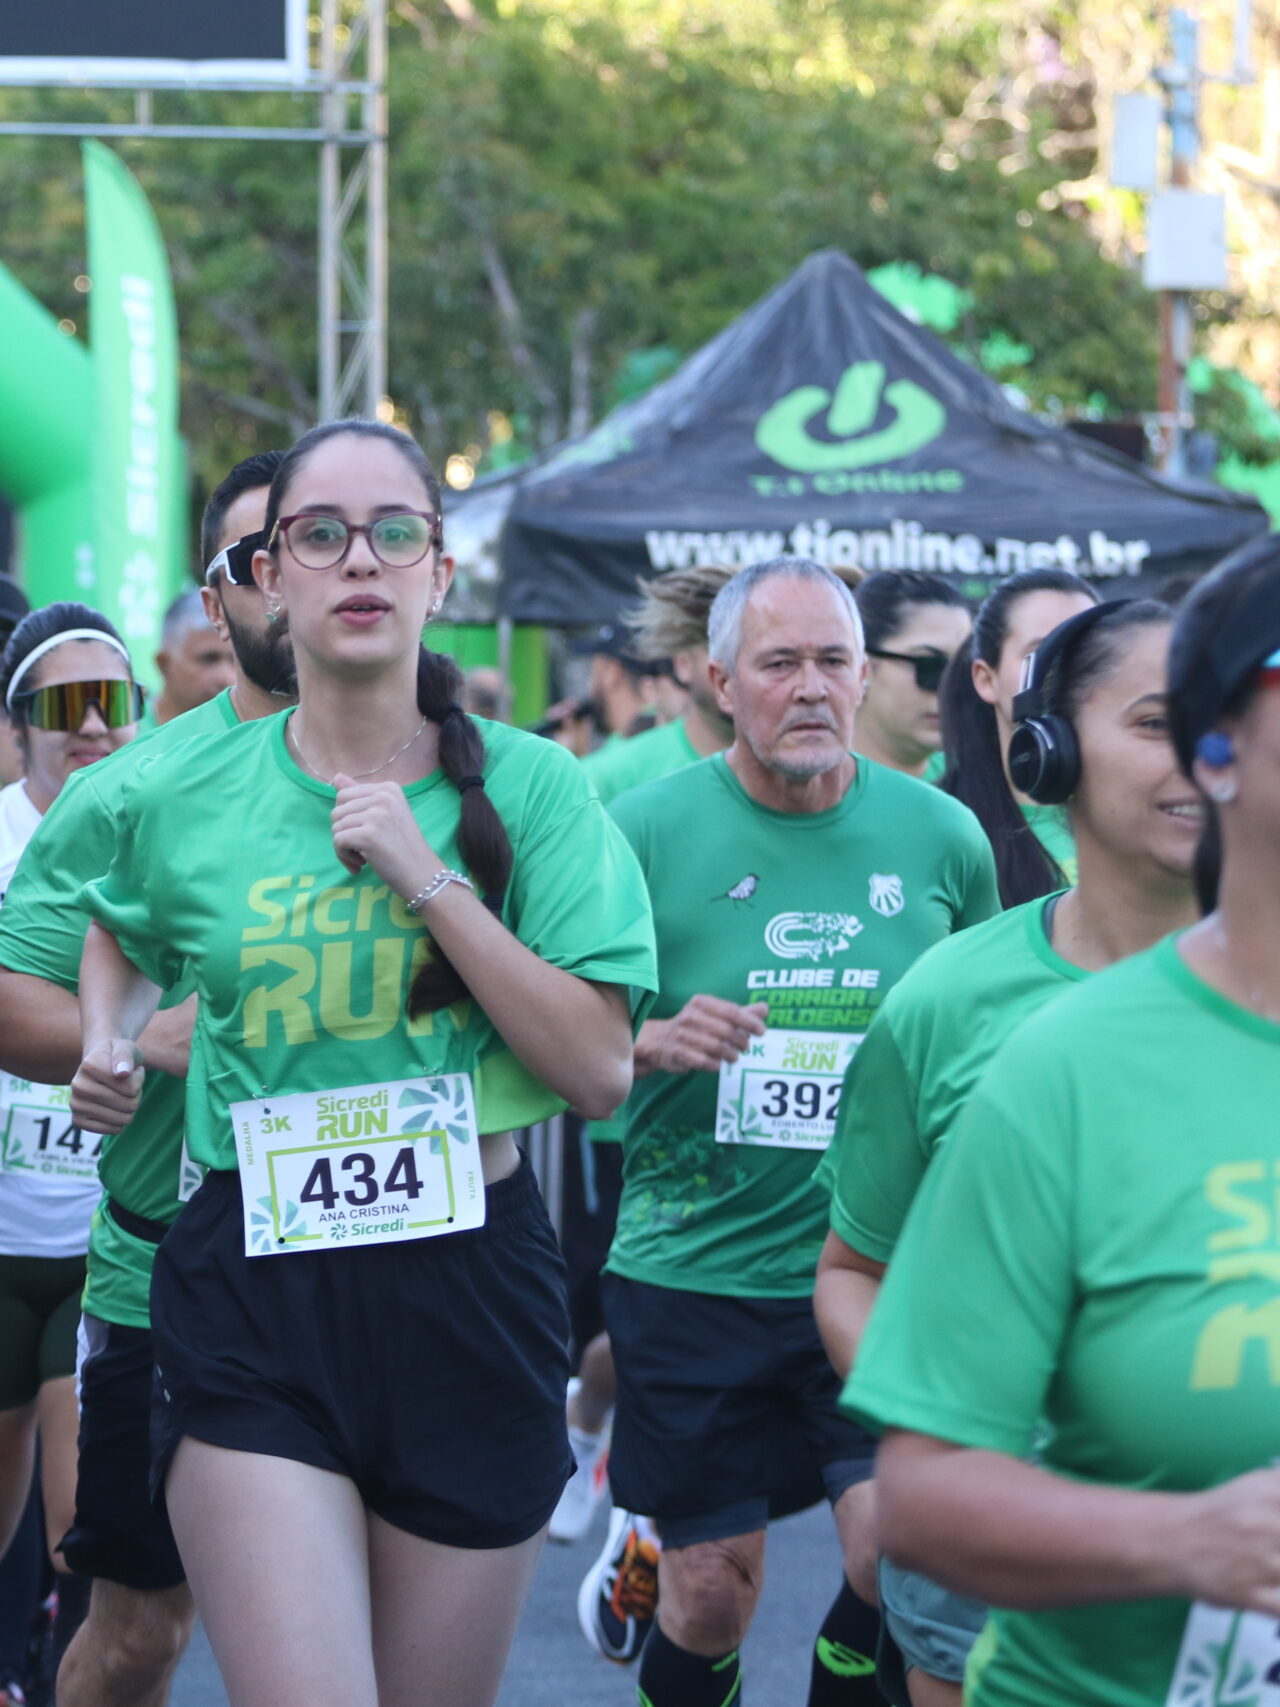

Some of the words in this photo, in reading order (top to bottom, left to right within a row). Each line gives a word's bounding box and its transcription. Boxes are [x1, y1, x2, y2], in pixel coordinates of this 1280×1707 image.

[747, 968, 835, 989] CLUBE
[841, 968, 880, 988] DE
[240, 937, 470, 1048] RU
[766, 1007, 875, 1026] ALDENS
[781, 1049, 837, 1071] RUN
[316, 1089, 389, 1114] Sicredi
[260, 1115, 292, 1134] 3K
[316, 1108, 389, 1141] RUN
[32, 1116, 102, 1157] 14
[242, 1121, 255, 1165] MEDALHA
[300, 1146, 424, 1210] 434
[318, 1210, 346, 1223] ANA
[350, 1203, 409, 1220] CRISTINA
[350, 1218, 404, 1237] Sicredi
